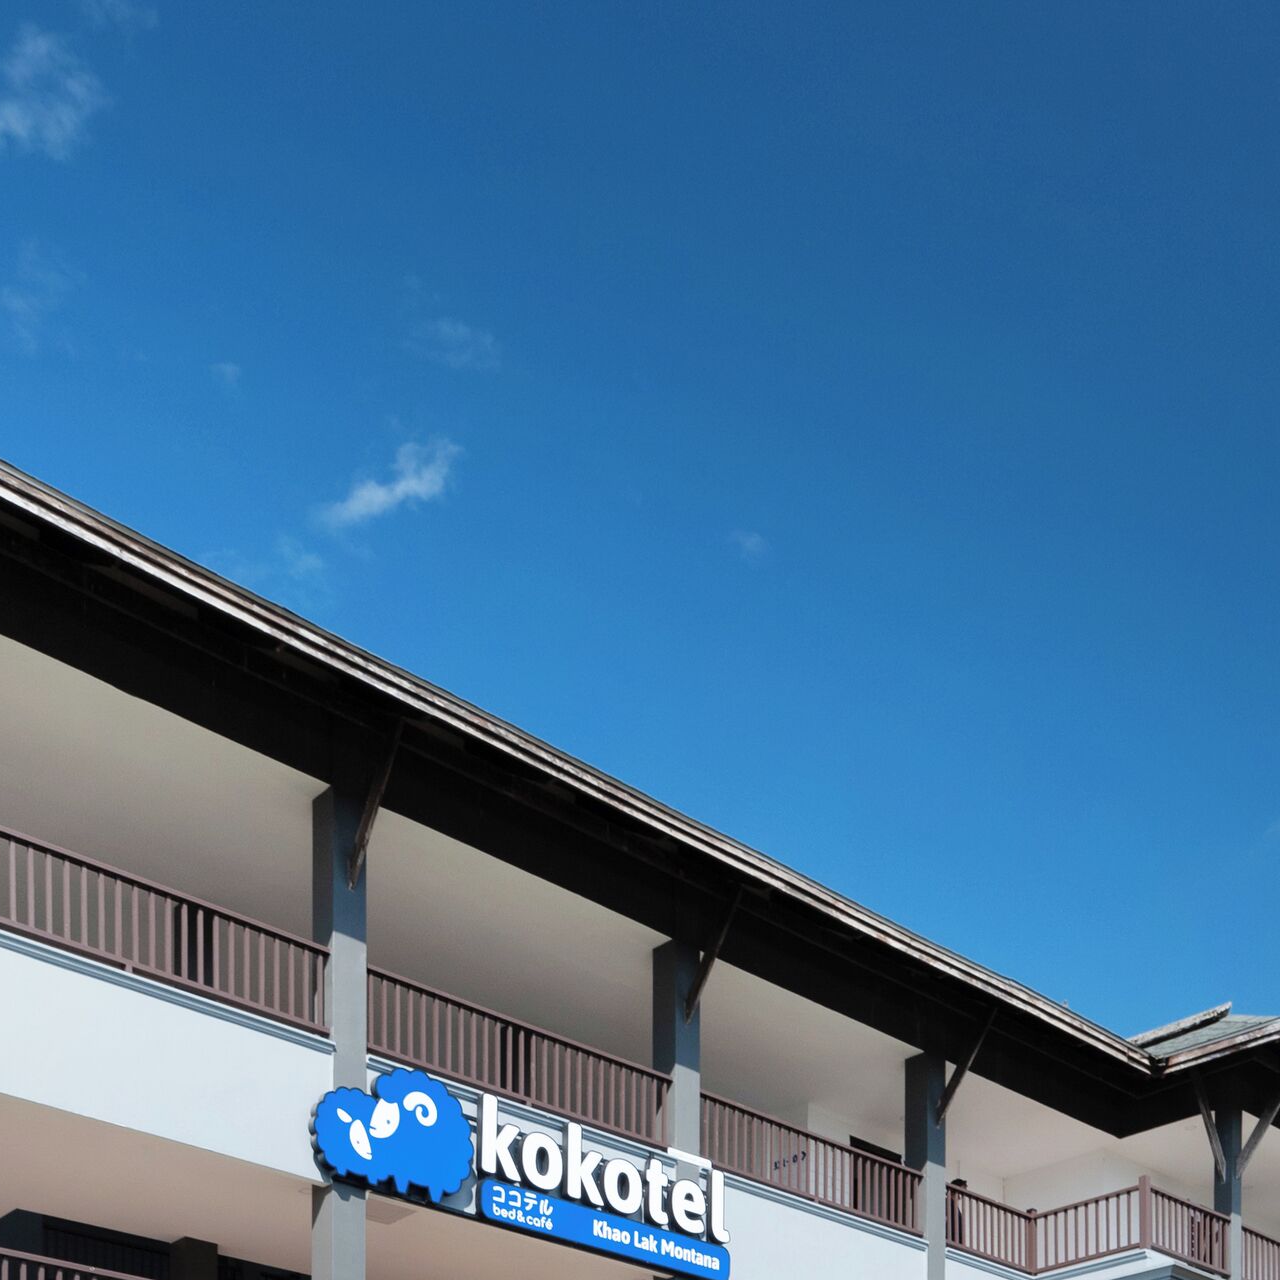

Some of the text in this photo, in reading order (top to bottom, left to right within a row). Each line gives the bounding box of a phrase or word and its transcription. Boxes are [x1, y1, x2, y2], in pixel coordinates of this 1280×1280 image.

[479, 1092, 731, 1244] kokotel
[492, 1185, 553, 1216] ココテル
[592, 1219, 720, 1270] Khao Lak Montana
